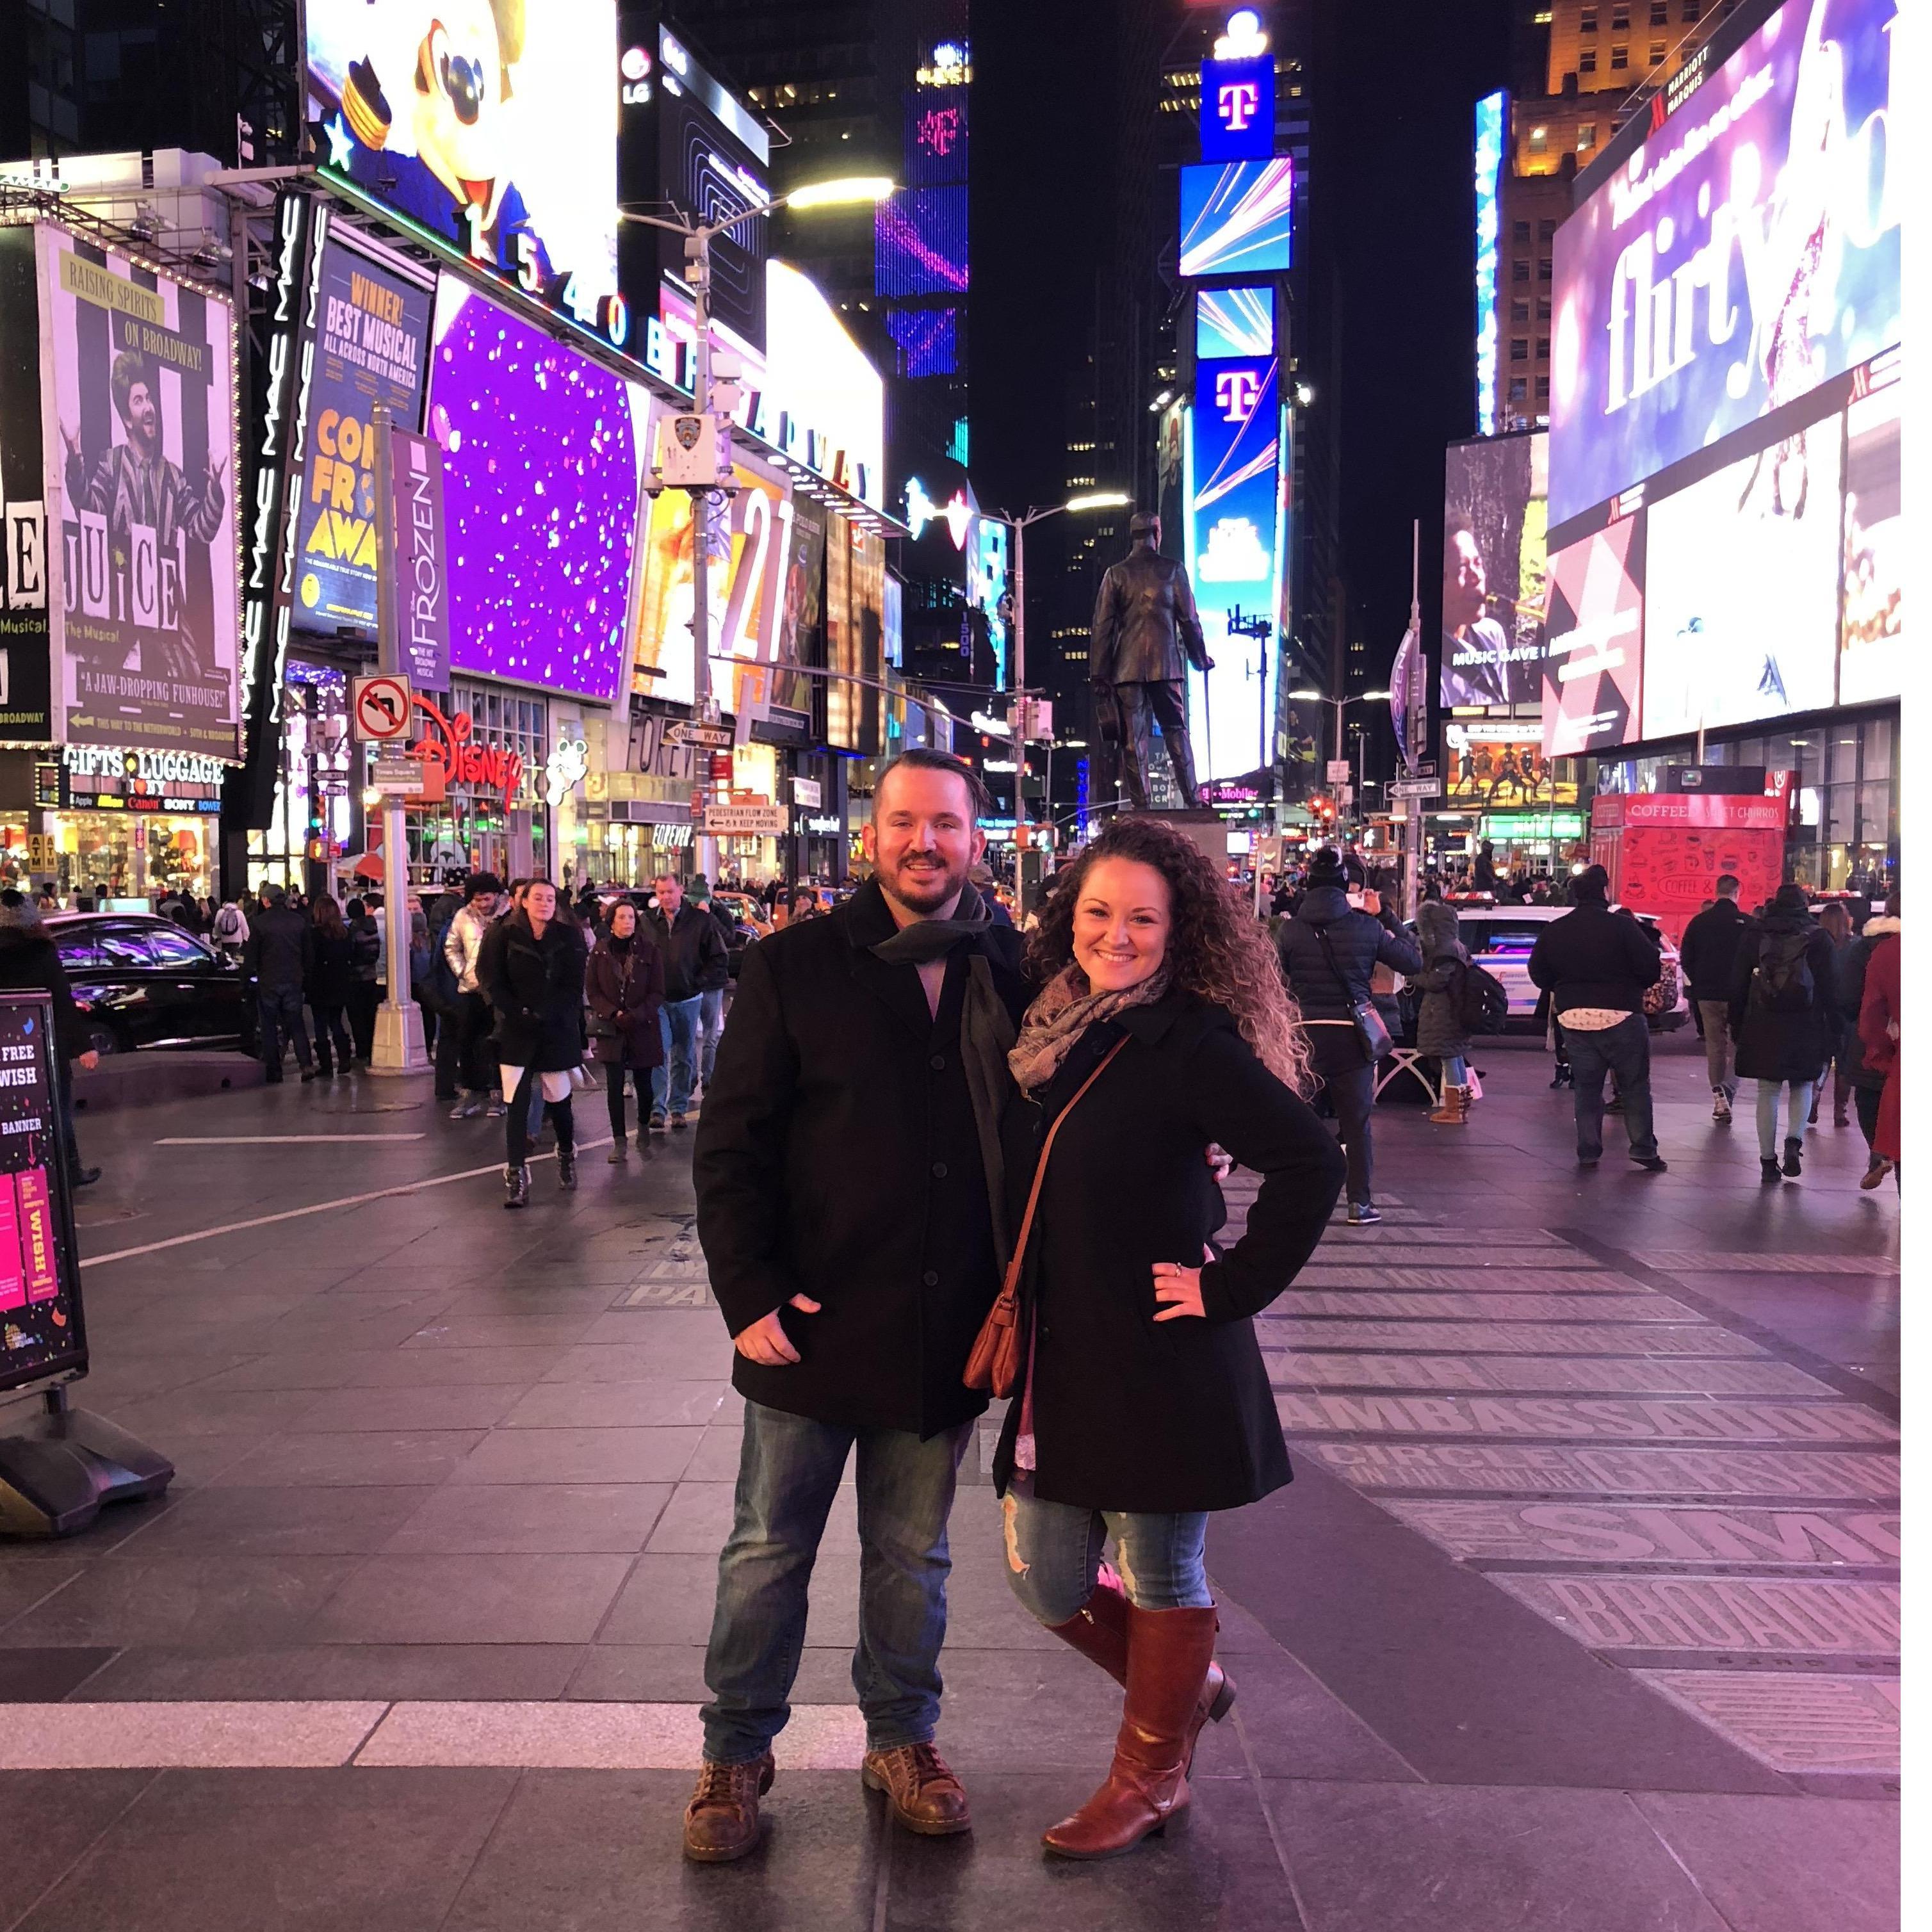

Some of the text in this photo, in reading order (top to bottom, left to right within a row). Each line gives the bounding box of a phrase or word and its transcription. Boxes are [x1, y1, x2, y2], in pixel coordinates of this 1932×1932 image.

[1668, 45, 1709, 97] MARRIOTT
[623, 85, 650, 104] LG
[1667, 70, 1703, 117] MARQUIS
[70, 261, 157, 322] RAISING SPIRITS
[351, 270, 405, 328] WINNER!
[326, 296, 362, 344] BEST
[362, 314, 417, 372] MUSICAL
[125, 320, 202, 372] ON BROADWAY!
[323, 334, 337, 355] ALL
[338, 339, 366, 368] ACROSS
[367, 352, 389, 377] NORTH
[388, 362, 416, 391] AMERICA
[305, 507, 377, 571] AWA
[409, 471, 441, 647] FROZEN
[1452, 646, 1538, 667] MUSIC GAVE
[94, 672, 169, 702] JAW-DROPPING
[674, 729, 726, 744] ONE WAY
[63, 747, 224, 785] GIFTS LUGGAGE
[145, 779, 166, 796] NY
[128, 796, 159, 810] Canon
[163, 799, 195, 811] SONY
[708, 808, 778, 818] PEDESTRIAN FLOW ZONE
[1737, 807, 1779, 819] CHURROS
[739, 819, 778, 828] KEEP MOVING
[32, 836, 41, 866] ATM
[1666, 879, 1696, 894] COFFEE
[2, 1044, 35, 1062] FREE
[0, 1066, 37, 1087] WISH
[1, 1117, 42, 1135] BANNER
[624, 1285, 706, 1305] PA
[1317, 1444, 1572, 1469] CIRCLE
